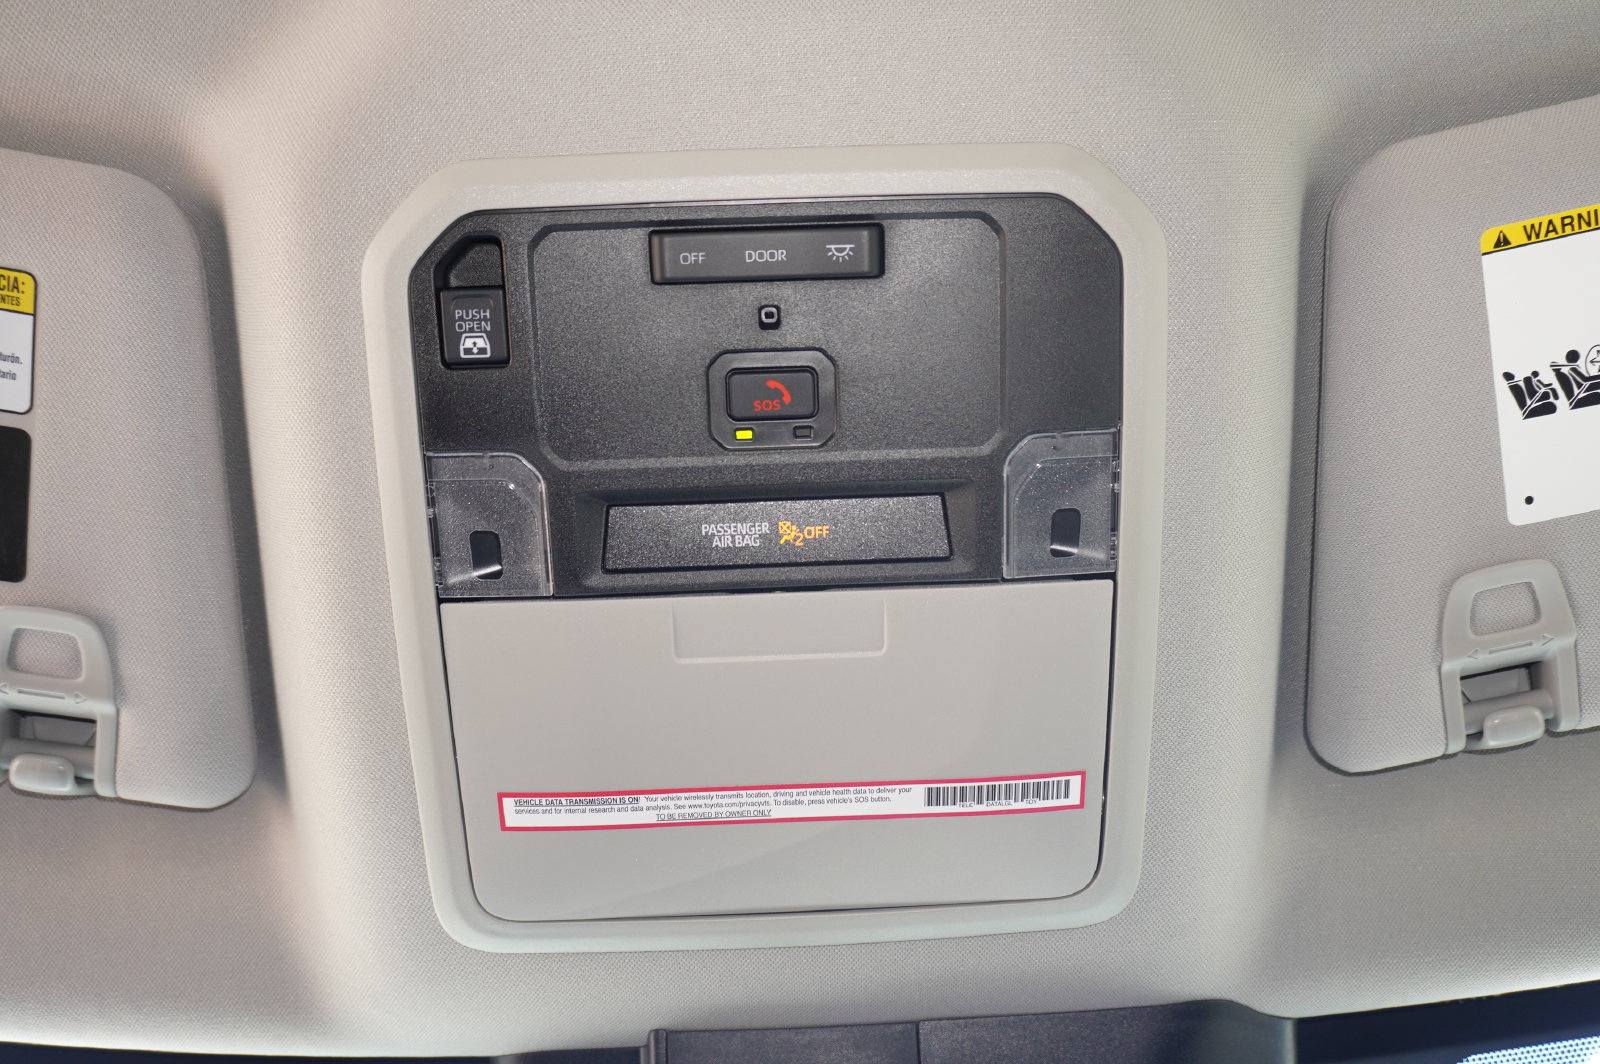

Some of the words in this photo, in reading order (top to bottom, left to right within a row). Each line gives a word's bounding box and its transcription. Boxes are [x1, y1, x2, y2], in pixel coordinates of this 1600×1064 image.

[680, 252, 706, 265] OFF
[745, 250, 787, 262] DOOR
[455, 309, 490, 320] PUSH
[456, 321, 491, 332] OPEN
[753, 400, 782, 411] SOS
[702, 522, 769, 535] PASSENGER
[803, 525, 829, 539] OFF
[712, 535, 733, 547] AIR
[735, 534, 759, 546] BAG
[513, 798, 543, 807] VEHICLE
[545, 798, 563, 806] DATA
[565, 796, 617, 806] TRANSMISSION
[644, 795, 658, 803] Your
[660, 794, 682, 802] vehicle
[684, 793, 714, 802] wirelessly
[715, 792, 744, 801] transmits
[746, 791, 771, 799] location,
[772, 790, 794, 799] driving
[809, 789, 831, 797] vehicle
[832, 788, 852, 796] health
[853, 788, 867, 796] data
[876, 786, 897, 795] deliver
[898, 787, 912, 796] your
[541, 807, 554, 815] and
[554, 807, 563, 815] for
[564, 806, 587, 815] internal
[588, 806, 616, 814] research
[616, 805, 629, 813] and
[645, 804, 672, 812] analysis.
[782, 798, 807, 806] disable,
[807, 798, 825, 806] press
[826, 796, 853, 804] vehicle's
[870, 795, 892, 803] button.
[656, 813, 666, 821] TO
[678, 812, 713, 820] REMOVED
